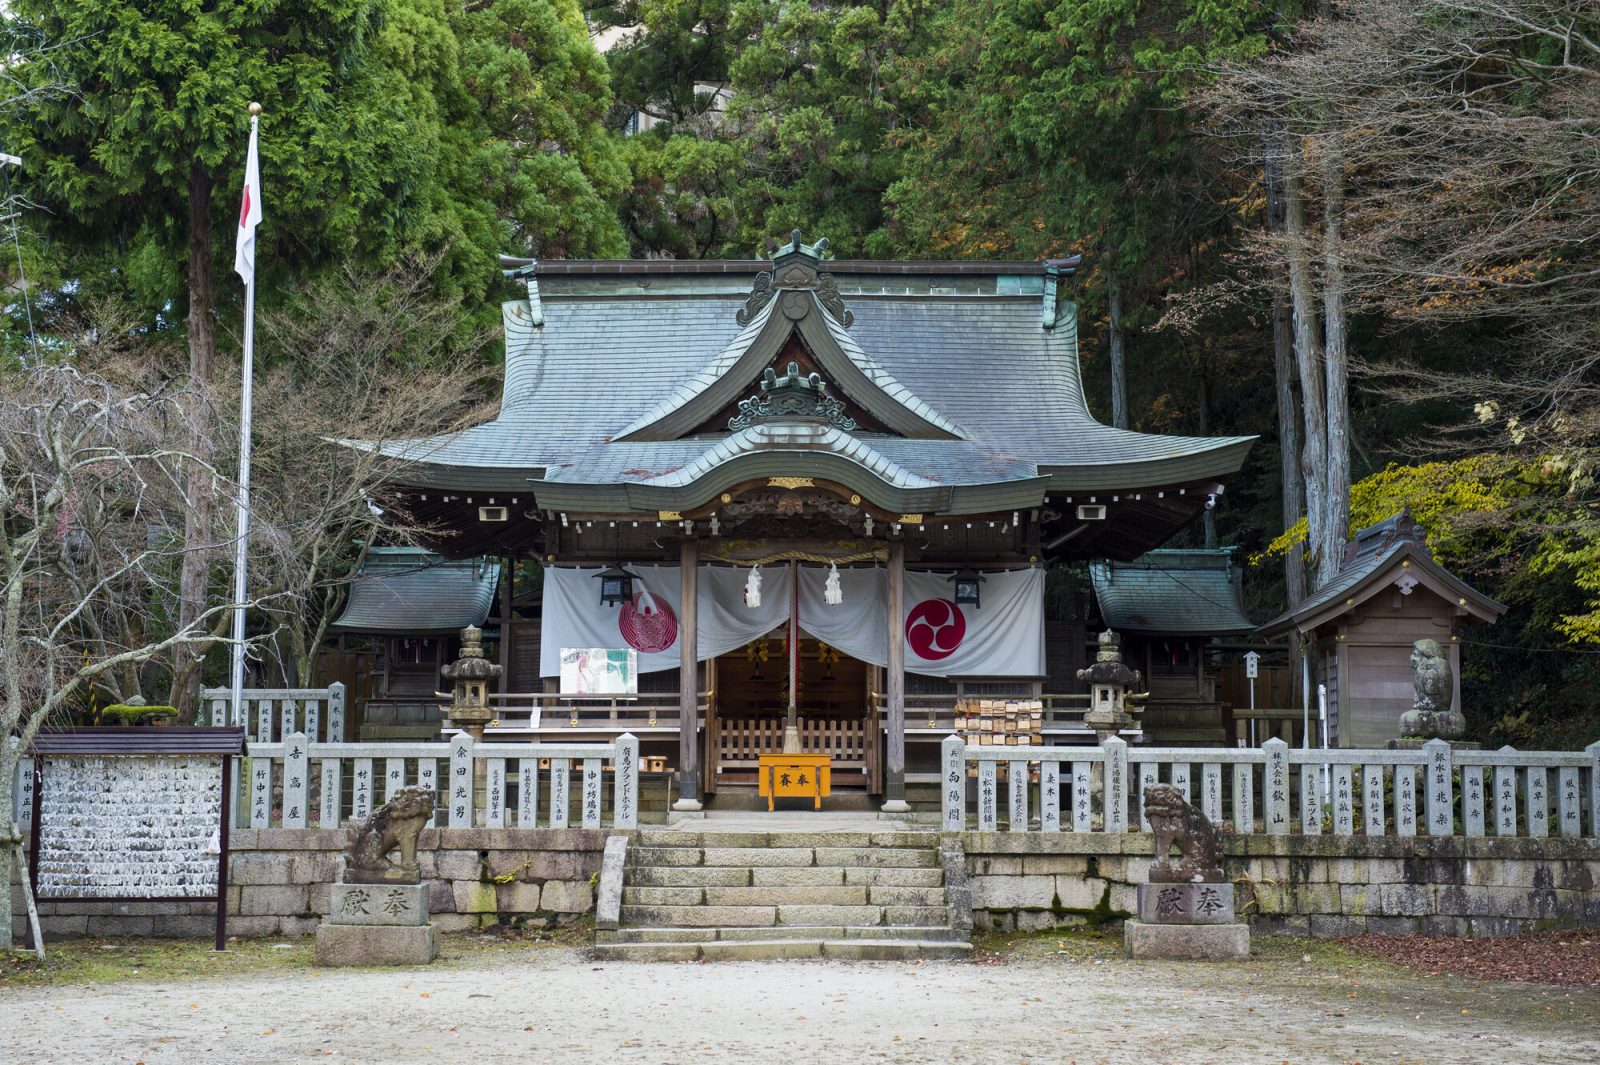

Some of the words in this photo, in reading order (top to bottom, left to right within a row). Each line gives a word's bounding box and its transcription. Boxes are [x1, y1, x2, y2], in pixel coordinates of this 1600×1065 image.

[22, 770, 34, 820] 竹中正行
[255, 769, 266, 819] 竹中正義
[288, 746, 303, 819] 吉高屋
[456, 746, 467, 818] 余田光男
[586, 770, 597, 819] 中の坊瑞苑
[622, 747, 631, 819] 有馬グランドホテル
[1272, 752, 1285, 824] 株式会社欽山
[1307, 774, 1318, 826] 株式会社三ツ森
